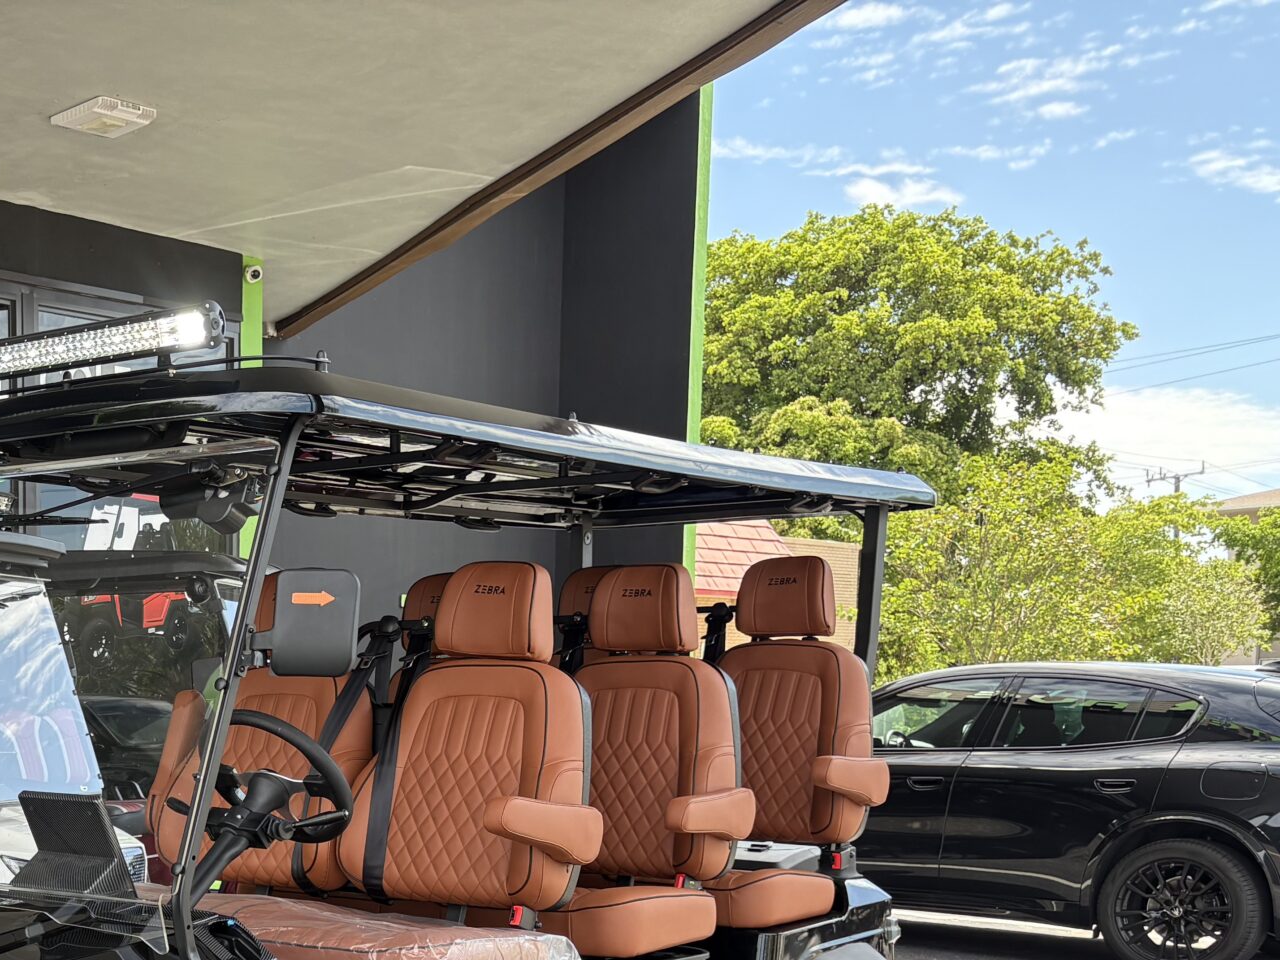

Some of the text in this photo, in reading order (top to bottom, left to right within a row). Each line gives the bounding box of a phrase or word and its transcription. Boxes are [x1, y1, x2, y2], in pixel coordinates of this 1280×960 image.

[768, 576, 797, 586] ZEBRA
[474, 584, 506, 595] ZEBRA
[622, 588, 652, 598] ZEBRA
